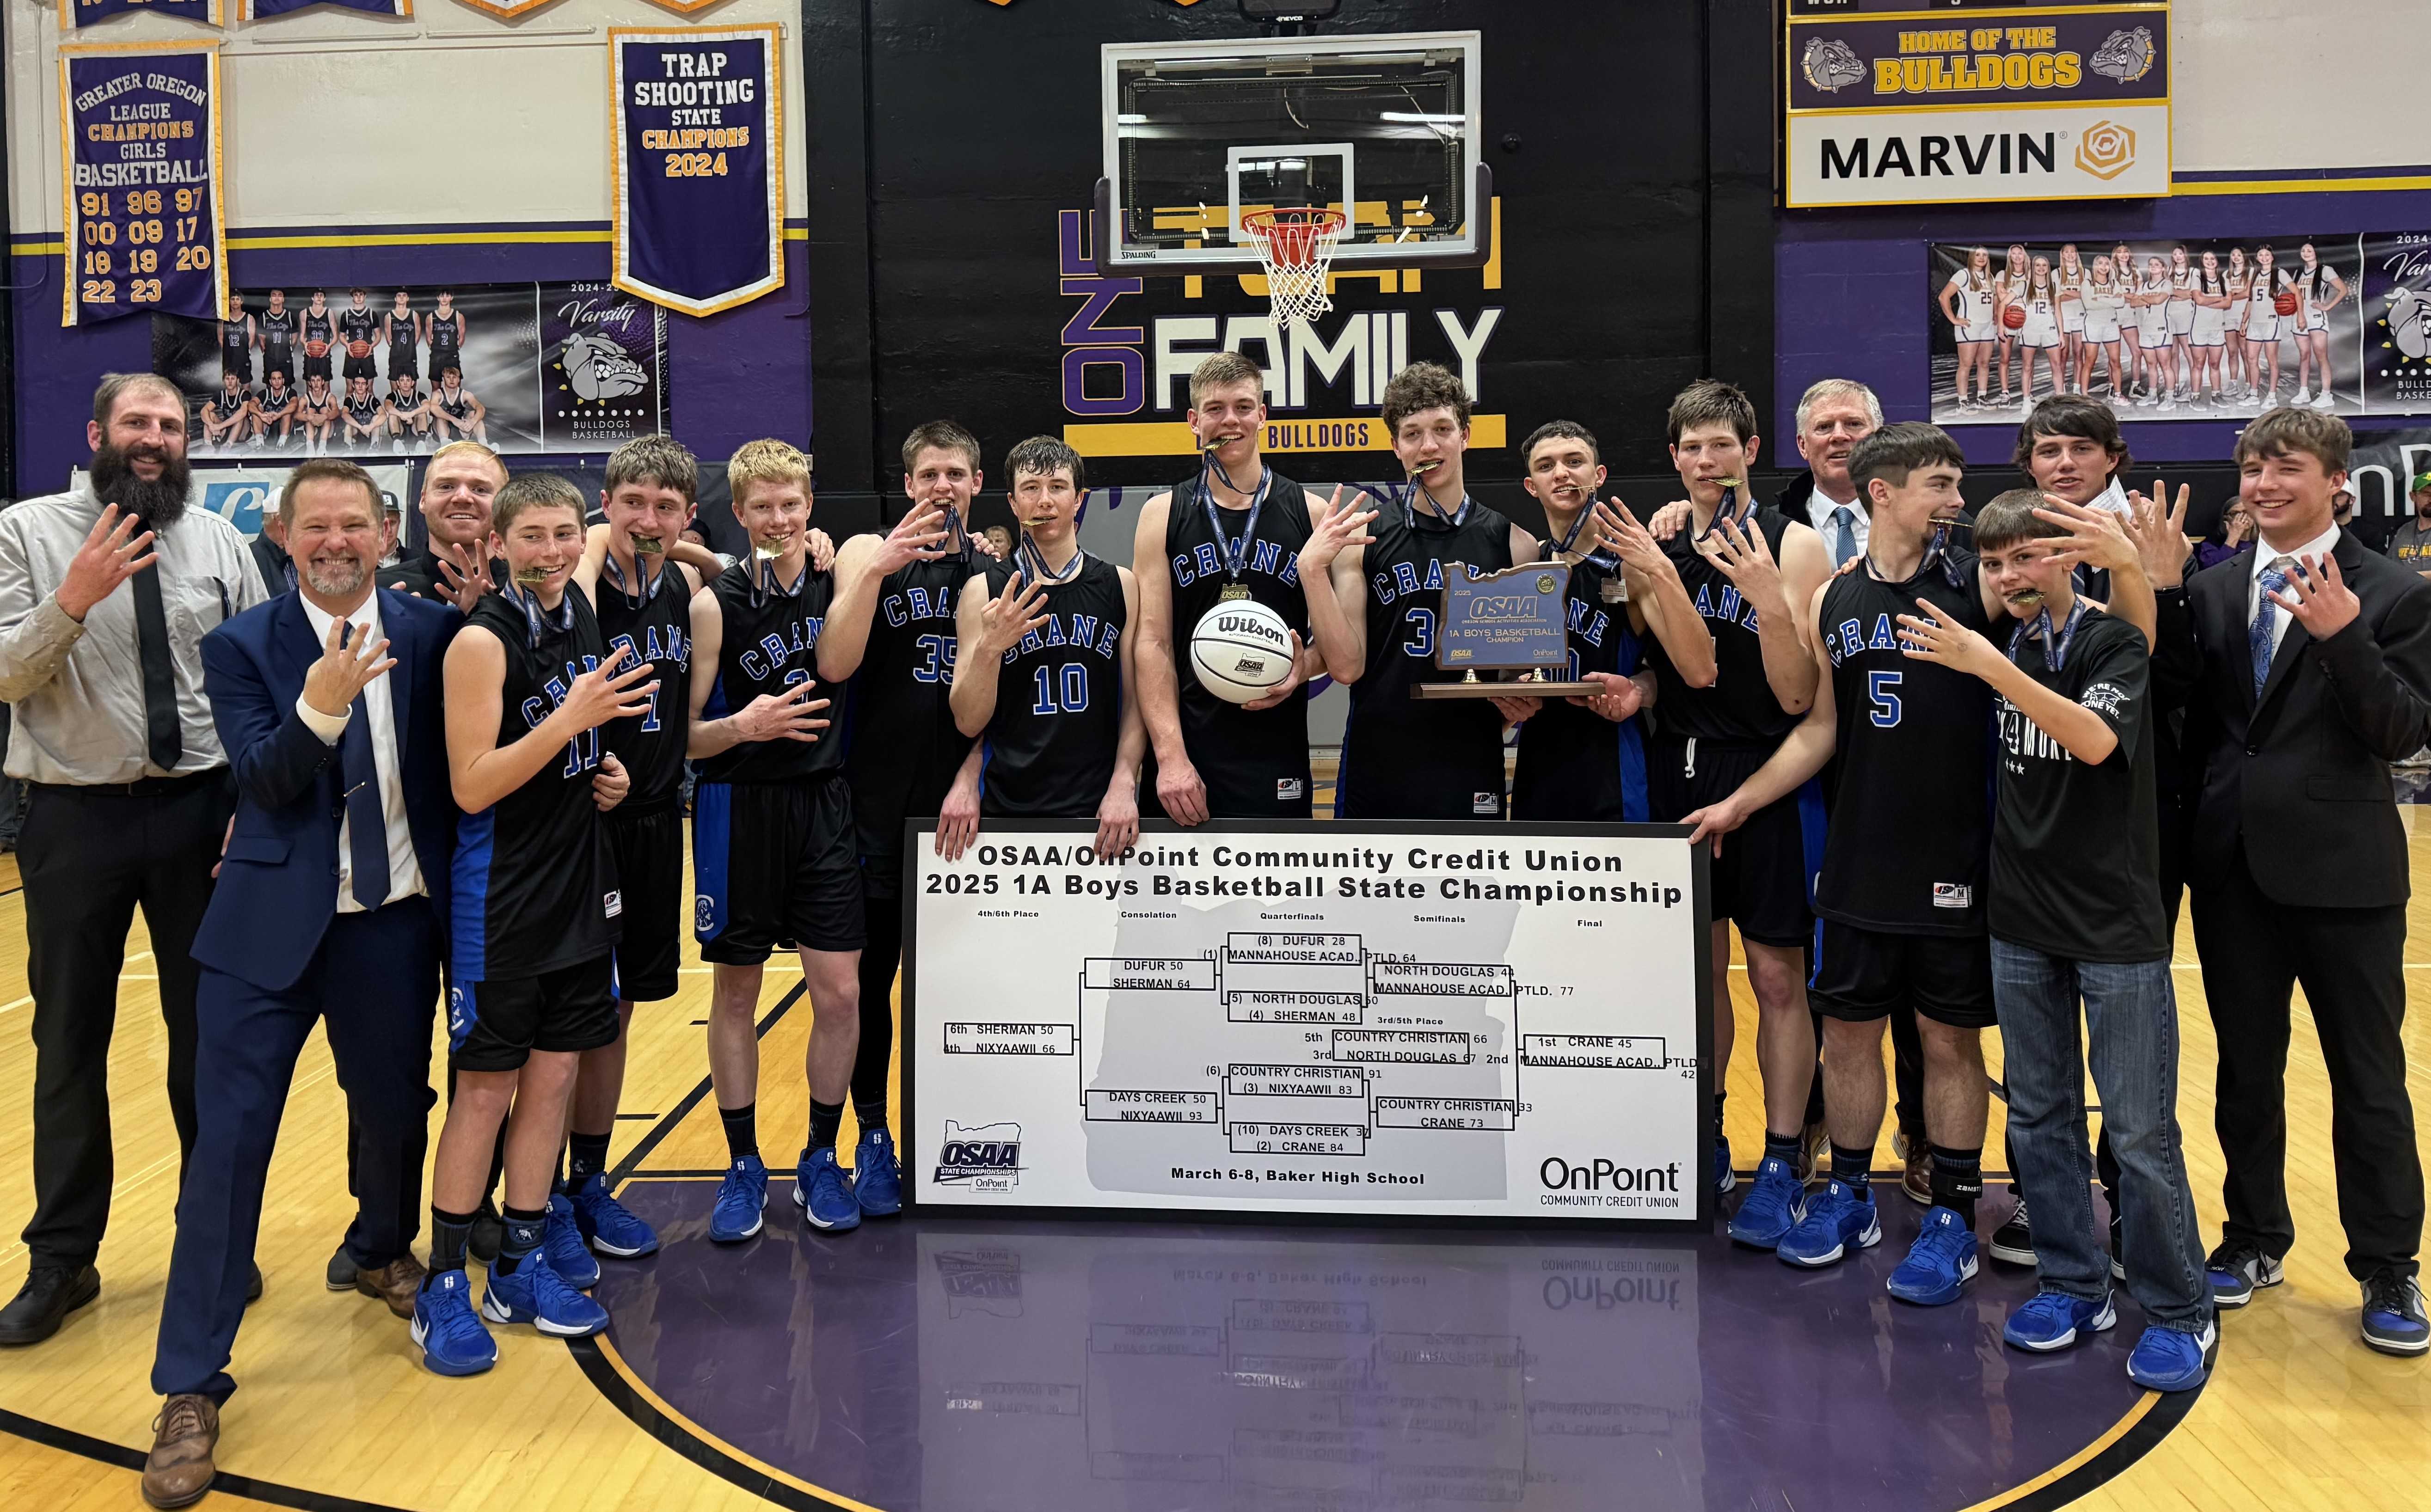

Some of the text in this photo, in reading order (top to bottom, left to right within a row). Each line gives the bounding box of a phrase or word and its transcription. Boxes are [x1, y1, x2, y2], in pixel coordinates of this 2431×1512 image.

[1899, 26, 2056, 53] HOME OF THE
[662, 53, 728, 78] TRAP
[1874, 52, 2082, 94] BULLDOGS
[75, 72, 207, 113] GREATER OREGON
[635, 79, 755, 107] SHOOTING
[110, 103, 171, 122] LEAGUE
[671, 108, 721, 126] STATE
[88, 121, 194, 141] CHAMPIONS
[641, 126, 750, 150] CHAMPIONS
[120, 142, 166, 159] GIRLS
[1821, 132, 2055, 179] MARVIN
[75, 159, 208, 187] BASKETBALL
[665, 153, 728, 178] 2024
[81, 187, 203, 216] 91 96 97
[84, 216, 197, 245] 00 09 17
[85, 246, 210, 275] 18 19 20
[1122, 251, 1156, 259] SPALDING
[83, 280, 162, 303] 22 23
[558, 299, 635, 332] Varsity
[1153, 306, 1504, 410] FAMILY
[572, 431, 636, 439] BASKETBALL
[574, 420, 630, 429] BULLDOGS
[1268, 423, 1369, 448] BULLDOGS
[1373, 558, 1479, 605] CRA
[1222, 591, 1247, 599] OSAA
[884, 587, 958, 627] CRA
[1469, 596, 1537, 619] OSAA
[1694, 583, 1760, 634] ANE
[1218, 617, 1284, 646] Wilson
[1495, 628, 1560, 637] BASKETBALL
[1826, 613, 1937, 668] CRAN
[740, 617, 823, 680] CRAN
[913, 634, 958, 685] 35
[1239, 660, 1264, 670] OSAA
[1033, 662, 1089, 715] 10
[1868, 670, 1903, 728] 5
[2082, 683, 2110, 698] WE'RE
[1213, 846, 1394, 874] Community
[1408, 848, 1510, 869] Credit
[1526, 850, 1622, 872] Union
[926, 874, 1682, 908] 2025 1A Boys Basketball State Championship
[1258, 936, 1345, 946] (8) DUFUR 28
[1124, 961, 1183, 971] DUFUR 50
[1203, 949, 1217, 961] (1)
[1229, 950, 1316, 961] MANNAHOUSE
[1403, 954, 1416, 962] 64
[1385, 965, 1428, 976] NORTH
[1432, 967, 1495, 977] DOUGLAS
[1113, 978, 1191, 989] SHERMAN 64
[1249, 1010, 1356, 1021] (4) SHERMAN 48
[950, 1024, 1053, 1035] 6th SHERMAN 50
[1538, 1037, 1632, 1048] 1st CRANE 45
[1206, 1065, 1382, 1079] (6) COUNTRY CHRISTIAN 91
[1486, 1054, 1509, 1064] 2nd
[1520, 1055, 1613, 1067] MANNAHOUSE
[1681, 1070, 1695, 1079] 42
[1109, 1092, 1206, 1103] DAYS CREEK 50
[1244, 1083, 1352, 1095] (3) NIXYAAWII 83
[1420, 1118, 1483, 1128] CRANE 73
[940, 1141, 1019, 1169] OSAA
[1257, 1141, 1344, 1152] (2) CRANE 84
[976, 1178, 1008, 1188] OnPoint
[1171, 1167, 1424, 1185] March 6-8, Baker High School
[1540, 1157, 1679, 1192] OnPoint
[1541, 1195, 1679, 1208] COMMUNITY CREDIT UNION
